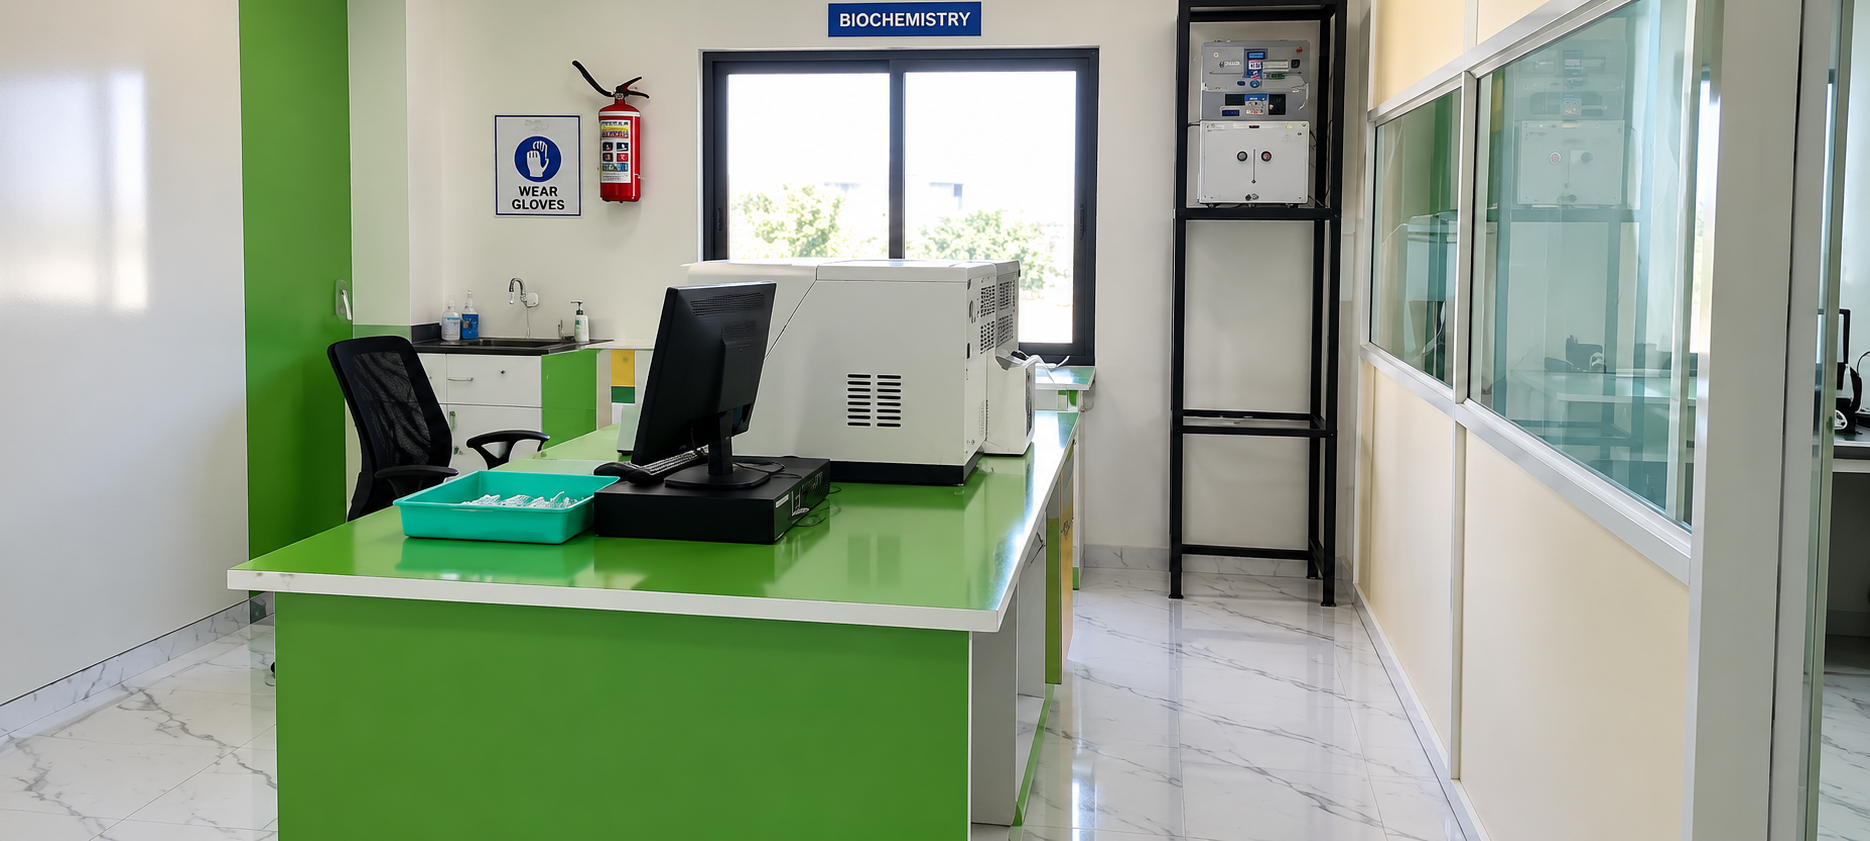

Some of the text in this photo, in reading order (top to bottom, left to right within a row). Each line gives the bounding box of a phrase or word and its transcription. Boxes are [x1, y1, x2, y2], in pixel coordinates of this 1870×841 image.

[839, 12, 971, 27] BIOCHEMISTRY
[518, 185, 558, 197] WEAR
[511, 198, 565, 210] GLOVES
